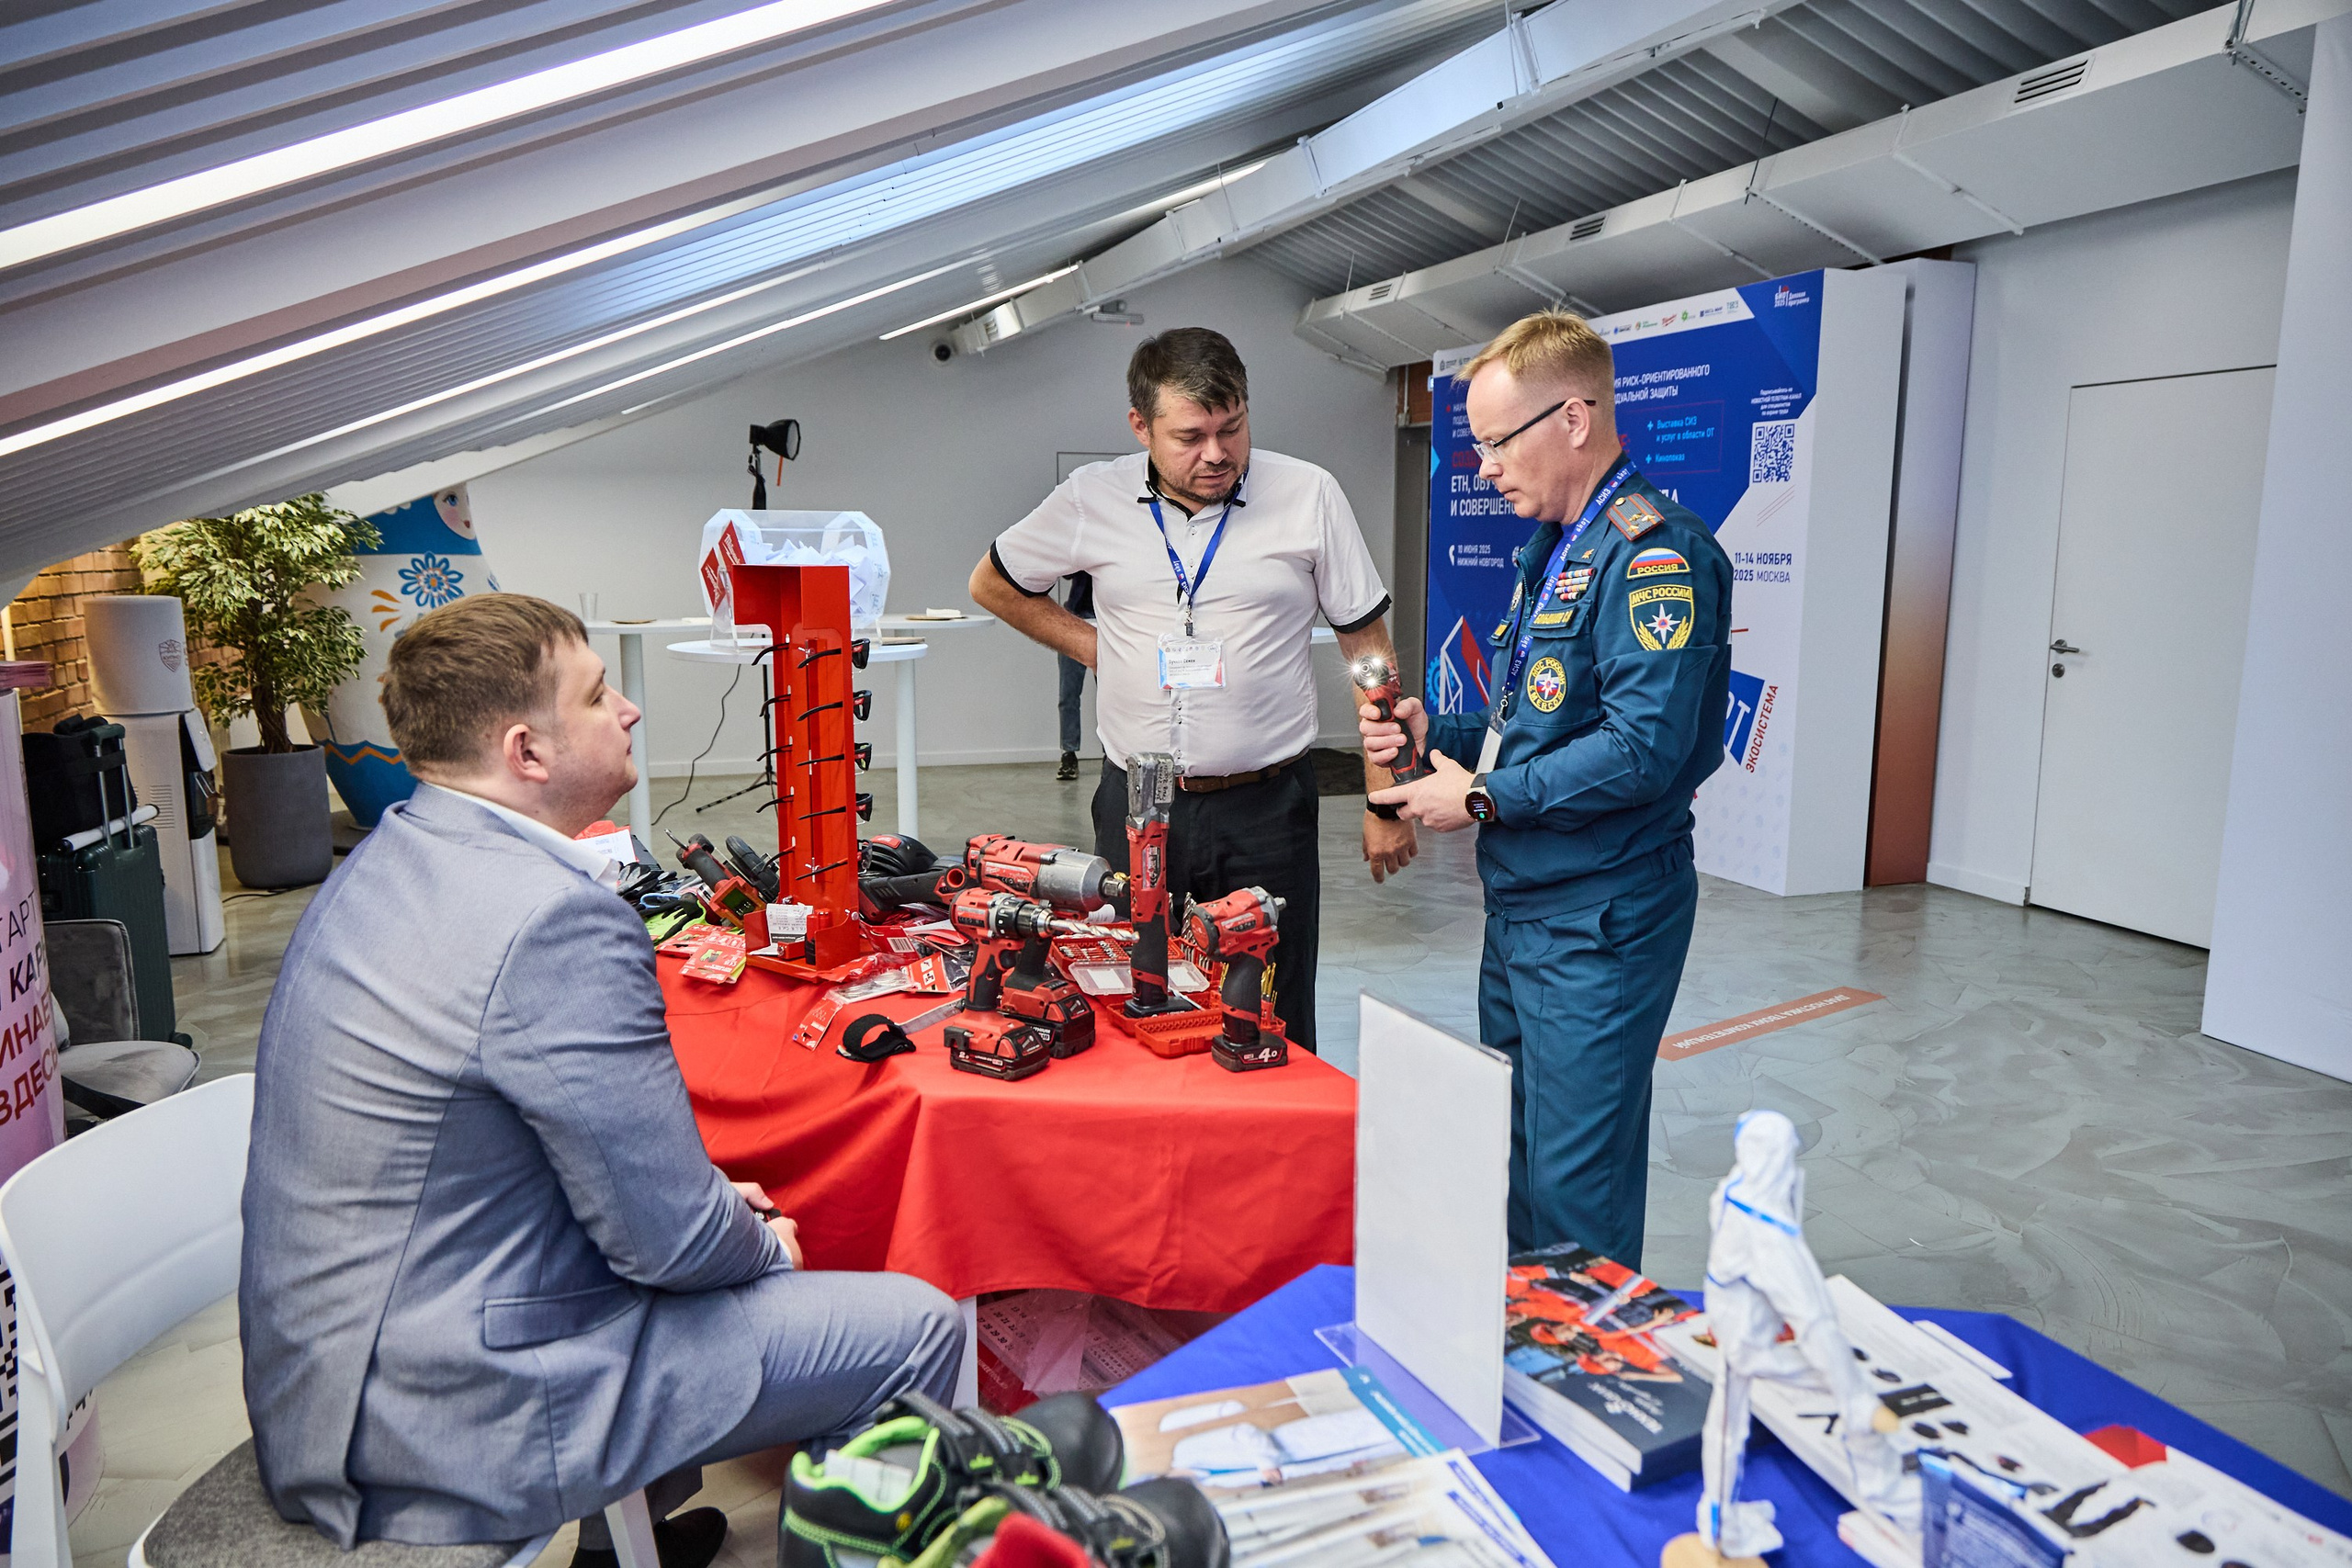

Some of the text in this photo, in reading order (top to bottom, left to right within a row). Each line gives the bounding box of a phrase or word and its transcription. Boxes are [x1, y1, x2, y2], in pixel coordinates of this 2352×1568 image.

[1623, 364, 1710, 387] РИСК-ОРИЕНТИРОВАННОГО
[1650, 385, 1679, 400] ЗАЩИТЫ
[1657, 416, 1697, 430] Выставка СИЗ
[1453, 429, 1457, 438] И
[1661, 431, 1677, 444] услуг
[1682, 429, 1705, 441] области
[1706, 427, 1714, 438] ОТ
[1656, 453, 1685, 463] Кинопоказ
[1452, 475, 1471, 493] ЕТН,
[1595, 488, 1611, 506] АСИЗ
[1451, 501, 1457, 516] И
[1478, 544, 1491, 554] 2025
[1559, 543, 1572, 562] АСИЗ
[1457, 555, 1505, 569] НИЖНИЙ НОВГОРОД
[1735, 552, 1792, 566] 11-14 НОЯБРЯ
[1637, 563, 1679, 574] РОССИЯ
[1734, 570, 1791, 583] 2025 МОСКВА
[1632, 587, 1692, 604] МЧС РОССИИ
[1510, 659, 1522, 677] АСИЗ
[1532, 659, 1566, 685] МЧС РОССИИ
[1529, 684, 1564, 710] EMERCOM
[1746, 685, 1779, 773] ЭКОСИСТЕМА
